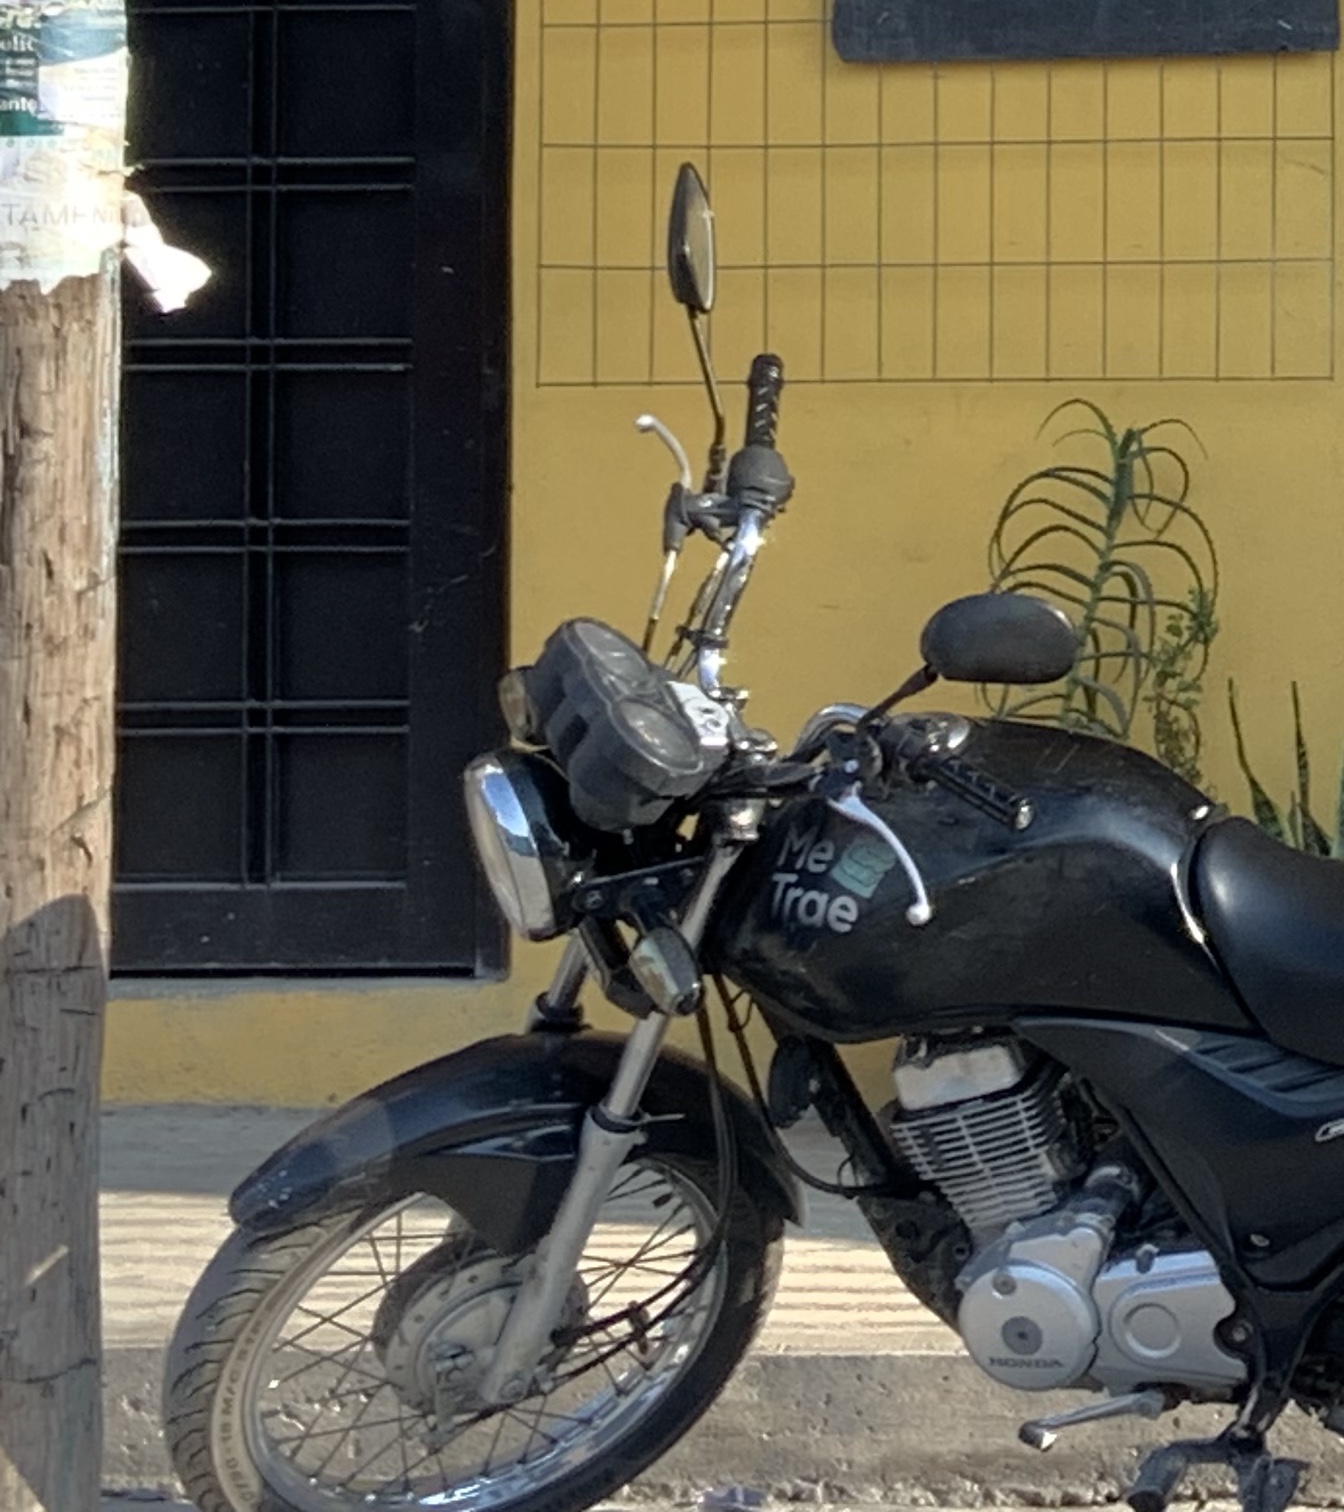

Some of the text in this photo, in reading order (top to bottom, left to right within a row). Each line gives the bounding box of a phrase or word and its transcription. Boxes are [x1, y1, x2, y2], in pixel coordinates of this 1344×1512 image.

[777, 825, 835, 873] Me
[772, 873, 858, 933] Trae
[988, 1357, 1065, 1369] HONDA
